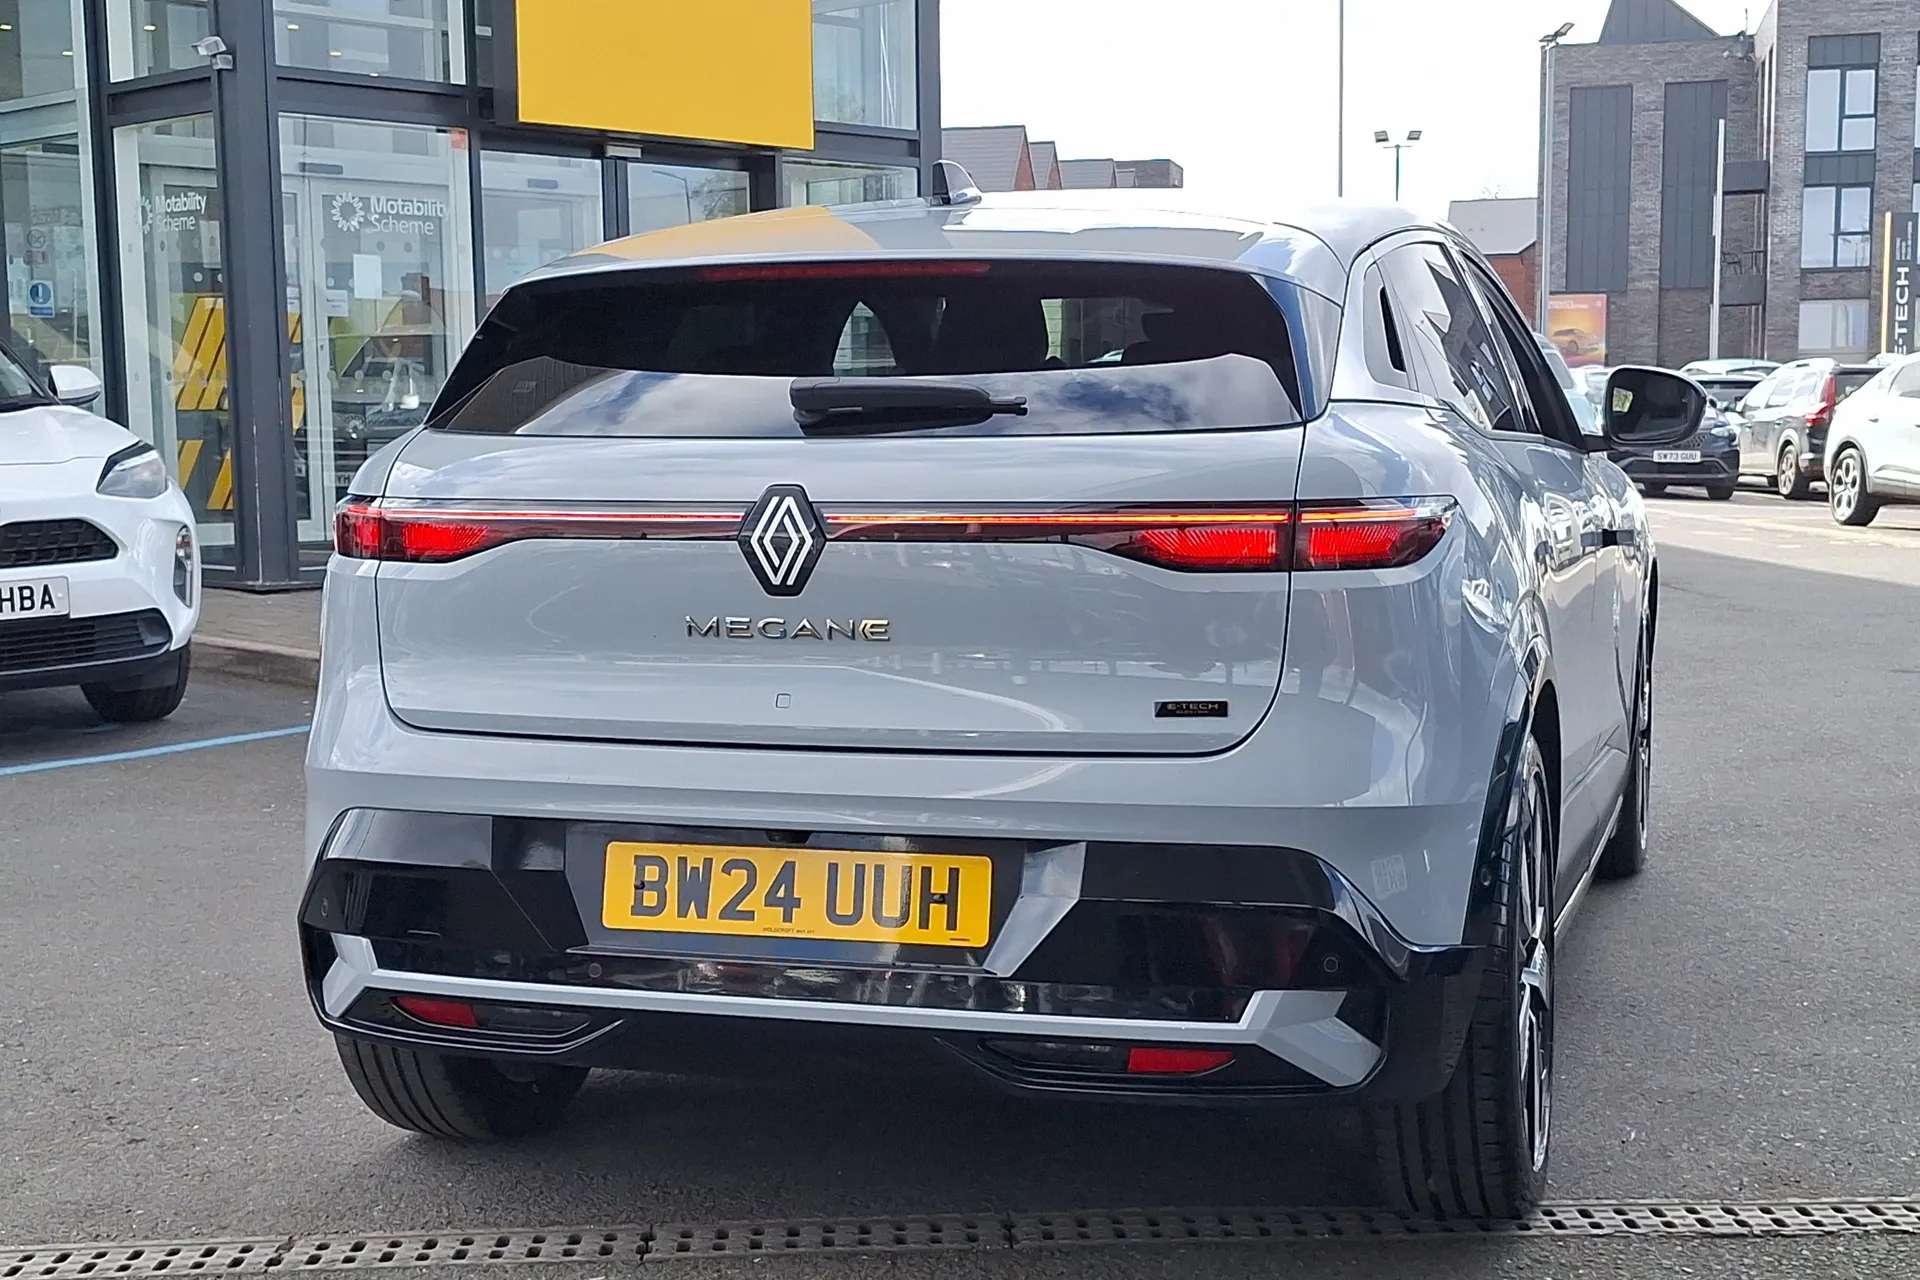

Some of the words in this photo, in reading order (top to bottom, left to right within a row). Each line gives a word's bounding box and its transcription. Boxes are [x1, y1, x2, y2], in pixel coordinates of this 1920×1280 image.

[155, 192, 207, 215] Motability
[156, 213, 196, 232] Scheme
[371, 214, 435, 235] Scheme
[0, 583, 56, 613] HBA
[684, 615, 891, 642] MEGANE
[630, 854, 801, 923] BW24
[825, 862, 960, 932] UUH
